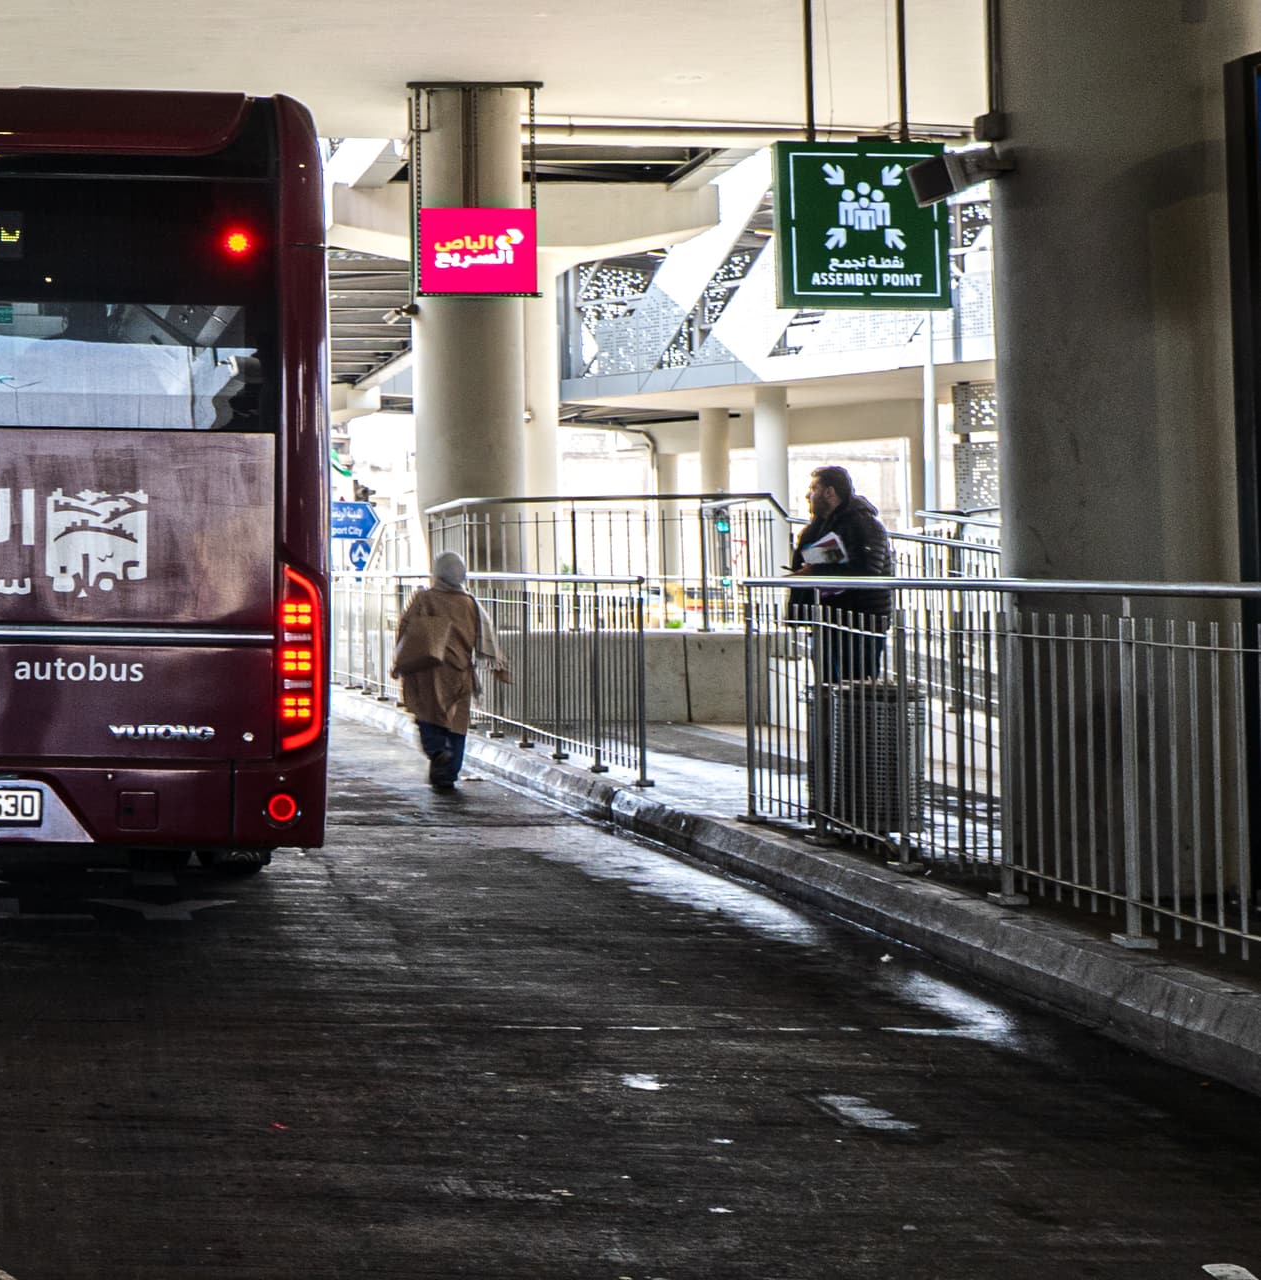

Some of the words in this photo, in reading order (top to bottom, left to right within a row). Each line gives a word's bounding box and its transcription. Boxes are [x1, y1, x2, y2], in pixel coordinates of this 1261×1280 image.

[434, 234, 494, 253] الباص
[434, 248, 515, 269] السريع
[828, 256, 866, 272] تجمع
[867, 254, 905, 269] نقطة
[811, 272, 878, 286] ASSEMBLY
[882, 273, 923, 287] POINT
[348, 526, 363, 537] City
[14, 655, 145, 682] autobus
[107, 724, 216, 741] YUTONG
